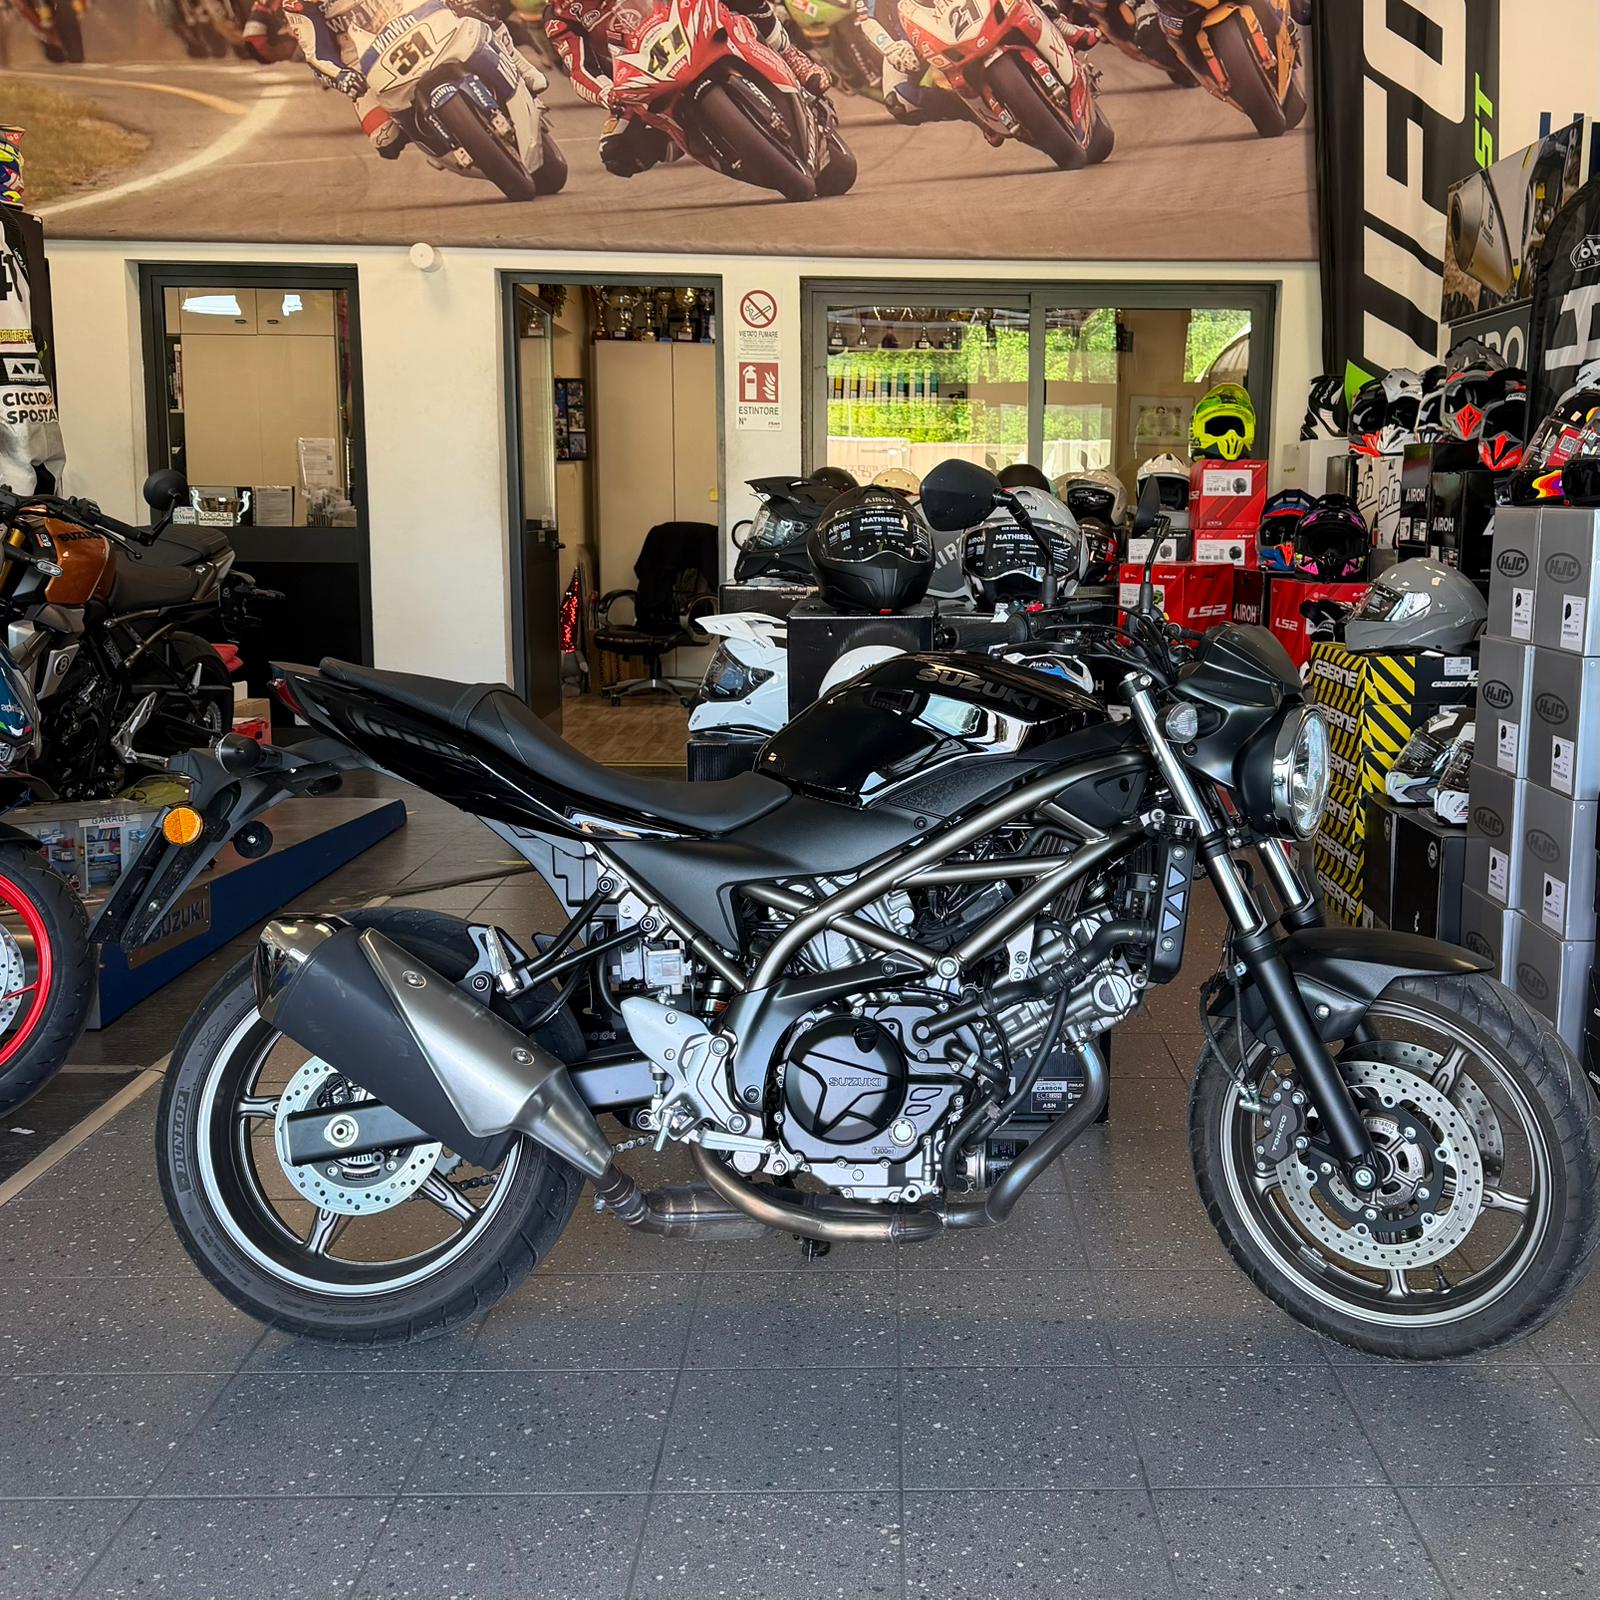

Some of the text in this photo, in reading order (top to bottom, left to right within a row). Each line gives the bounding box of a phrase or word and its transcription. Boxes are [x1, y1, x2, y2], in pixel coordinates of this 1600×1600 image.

[371, 13, 418, 55] WinWin
[389, 31, 435, 76] 31
[738, 330, 758, 338] VIETATO
[3, 392, 48, 407] CICCIO
[738, 406, 779, 415] ESTINTORE
[864, 497, 897, 505] AIROH
[1405, 487, 1426, 503] AIROH
[828, 521, 850, 535] AIROH
[860, 516, 900, 524] MATHISSE
[1432, 516, 1455, 533] AIROH
[1500, 555, 1525, 572] HJC
[1549, 559, 1577, 577] HJC
[1187, 603, 1228, 619] LS2
[1233, 603, 1258, 624] AIROH
[1275, 617, 1298, 631] LS2
[915, 667, 1041, 713] SUZUKI
[1486, 685, 1509, 704] HJC
[1539, 698, 1565, 719] HJC
[1329, 755, 1358, 780] ERNE
[91, 814, 131, 826] GARAGE
[1476, 812, 1500, 834] HJC
[1529, 836, 1556, 860] HJC
[1519, 969, 1545, 997] HJC
[828, 1076, 882, 1087] SUZUKI
[173, 1094, 186, 1175] DUNLOP
[1271, 1114, 1287, 1152] TOKICO
